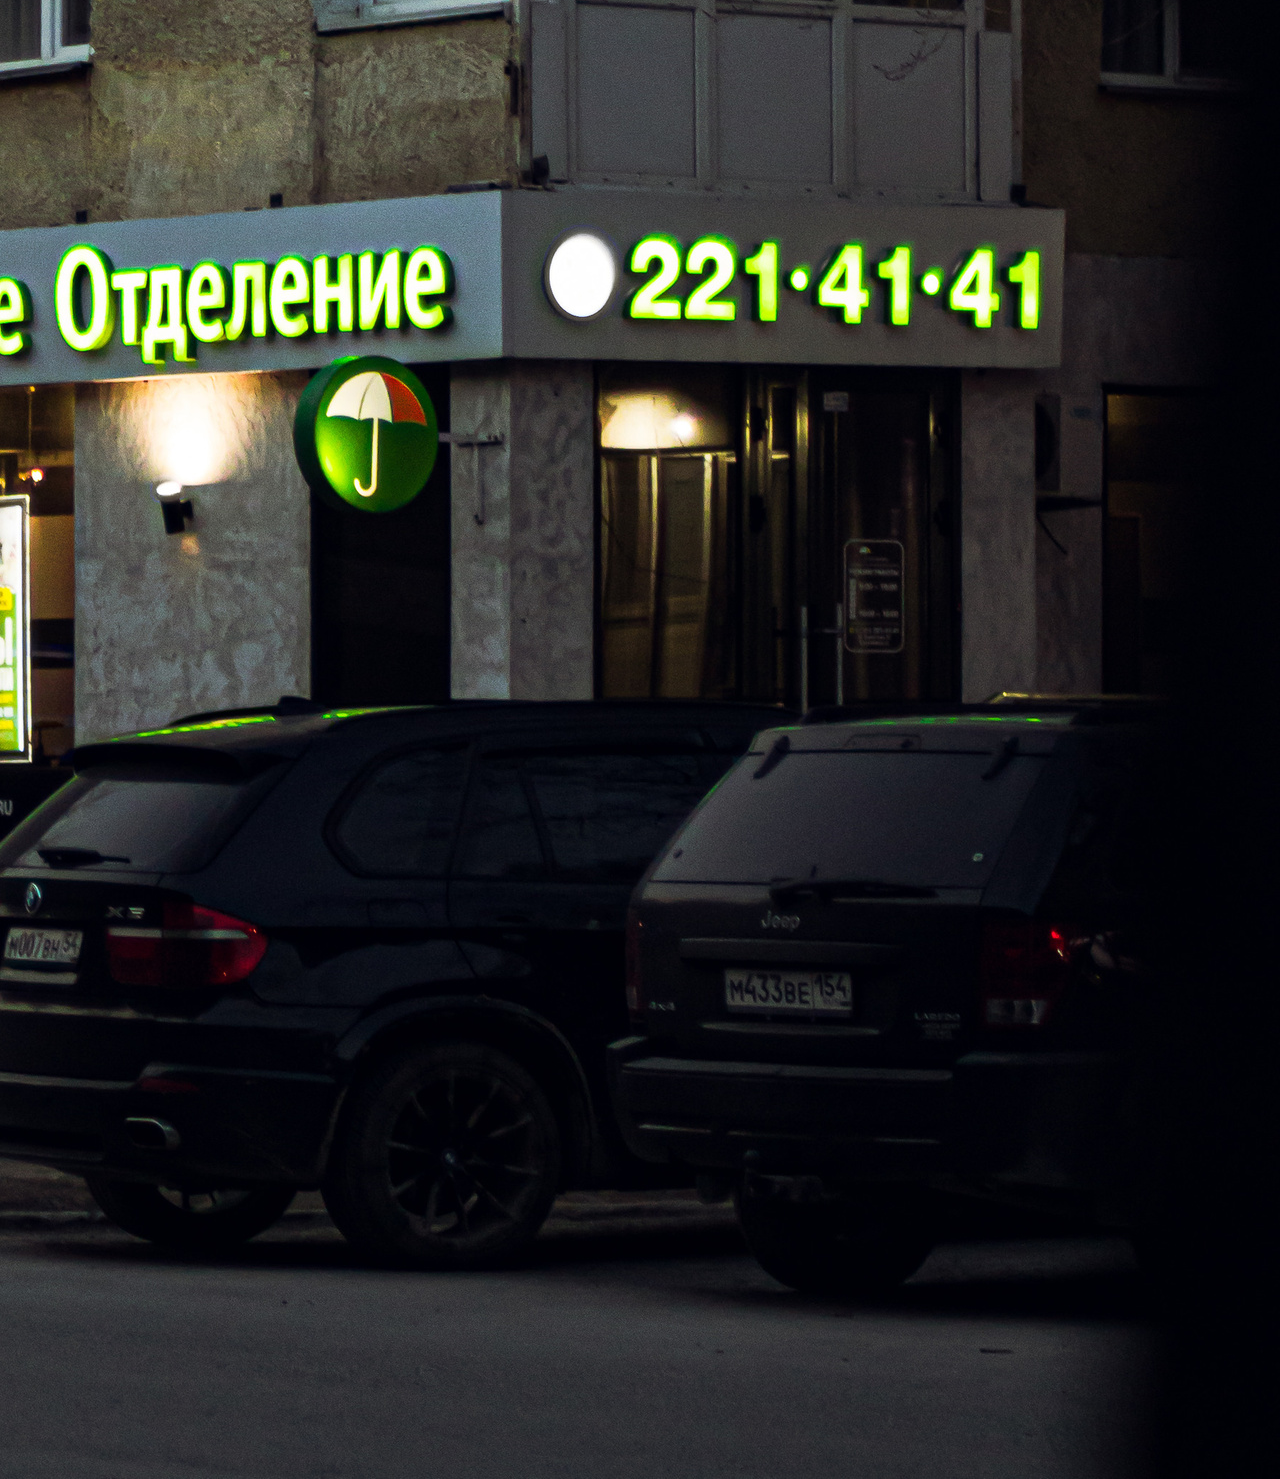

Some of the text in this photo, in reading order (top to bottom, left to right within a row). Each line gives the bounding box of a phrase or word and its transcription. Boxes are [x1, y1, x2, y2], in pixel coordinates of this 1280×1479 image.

[55, 243, 448, 364] Отделение
[761, 910, 801, 932] Jeep
[814, 973, 848, 998] 154
